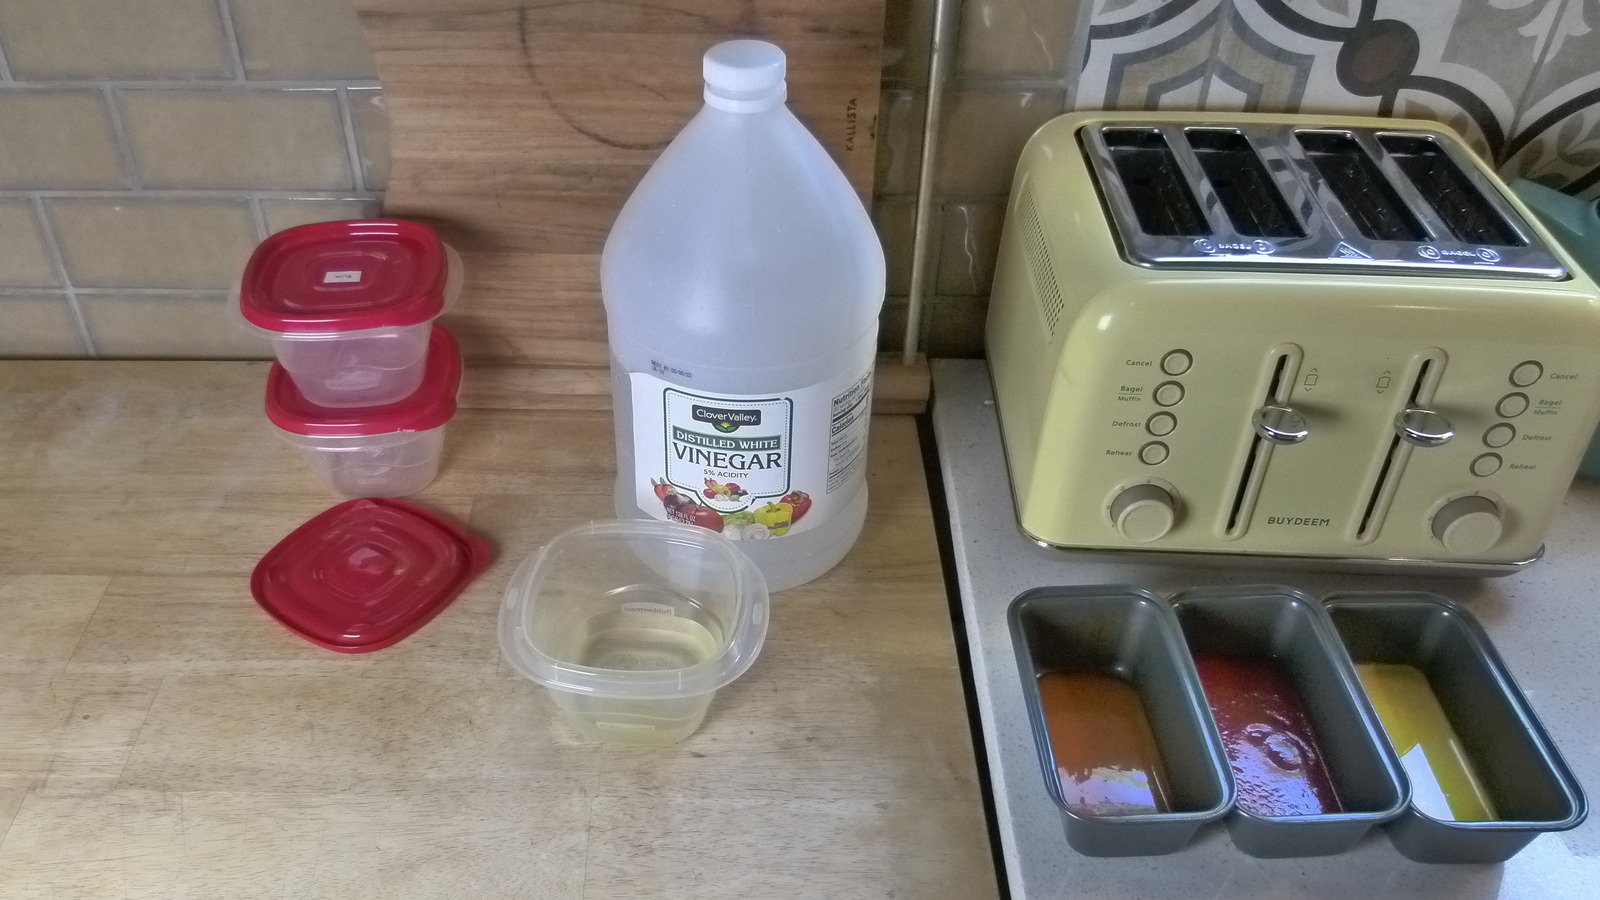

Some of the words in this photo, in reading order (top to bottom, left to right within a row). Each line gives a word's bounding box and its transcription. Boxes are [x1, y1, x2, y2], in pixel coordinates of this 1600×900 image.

[845, 97, 857, 152] KALLISTA
[833, 384, 861, 407] Nutrition
[1120, 385, 1143, 393] Bagel
[831, 415, 855, 434] Calories
[676, 430, 736, 449] DISTILLED
[739, 439, 778, 450] WHITE
[672, 441, 782, 470] VINEGAR
[703, 468, 716, 476] 5%
[717, 471, 749, 479] ACIDITY
[1267, 516, 1330, 526] BUYDEEM
